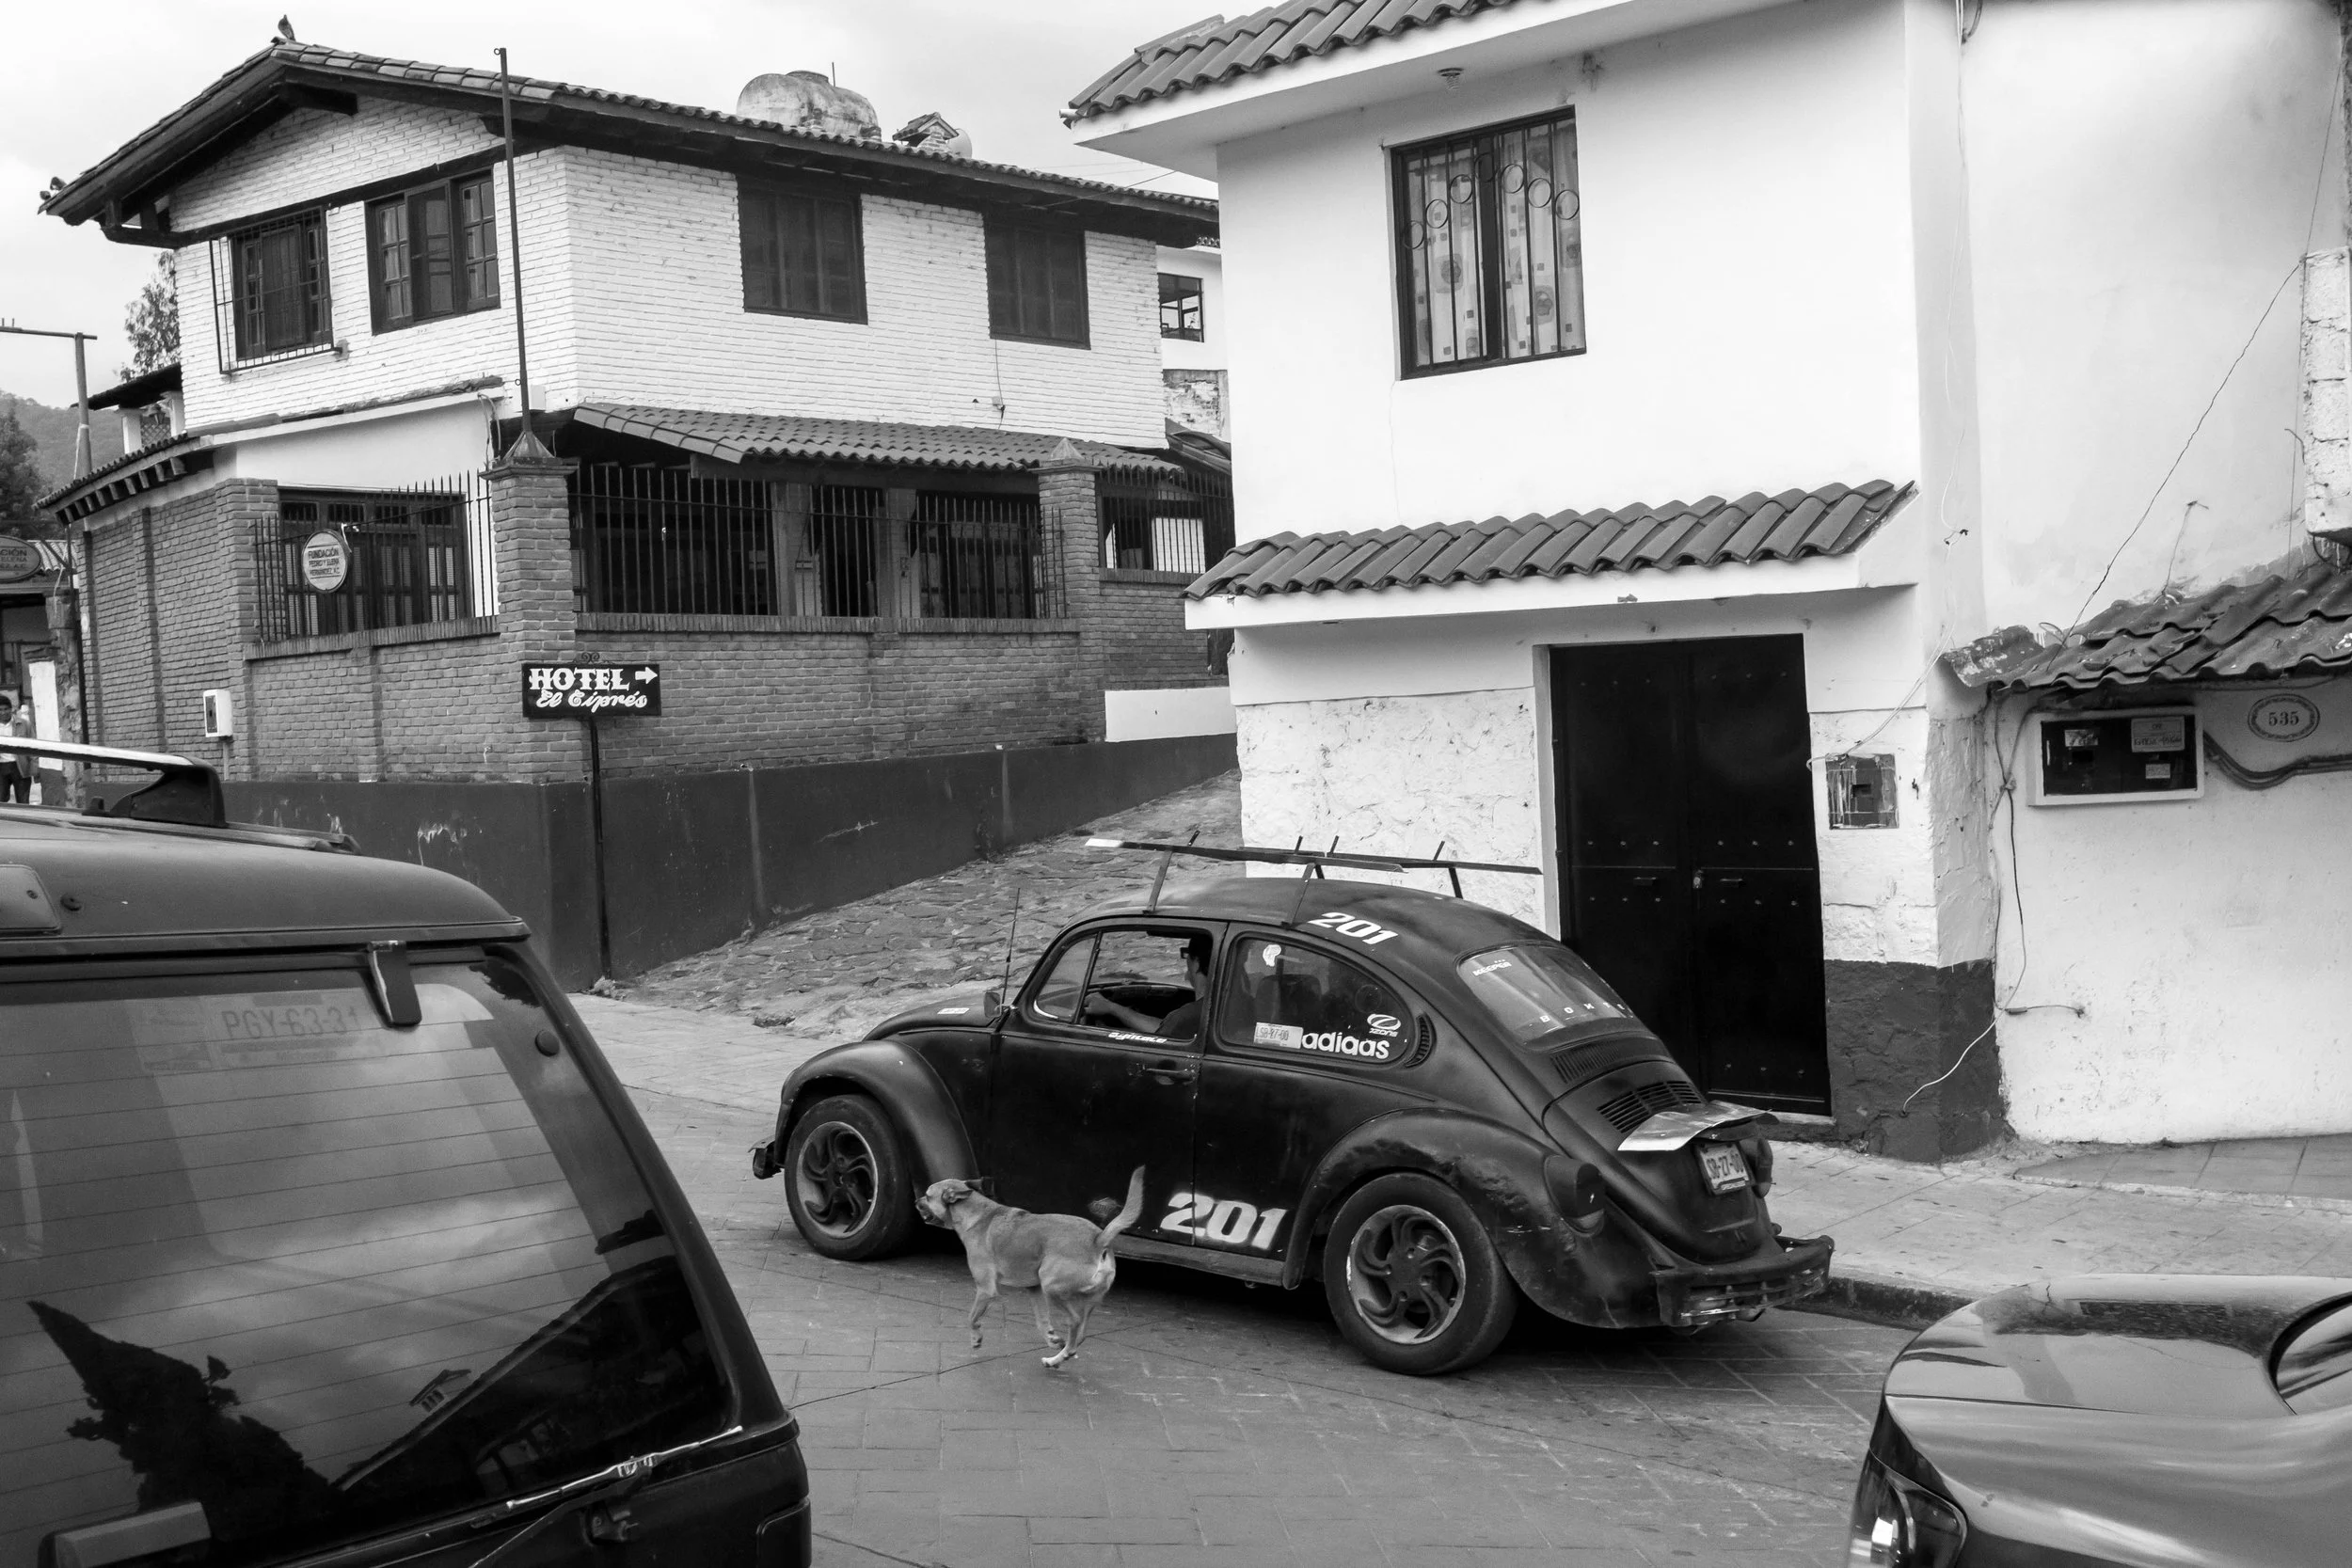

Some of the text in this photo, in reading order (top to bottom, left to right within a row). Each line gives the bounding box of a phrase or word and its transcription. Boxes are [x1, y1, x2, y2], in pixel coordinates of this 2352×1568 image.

[0, 546, 27, 556] CIÓN
[309, 547, 339, 559] FUNDACIÓN
[326, 558, 339, 566] ELENA
[529, 667, 630, 691] HOTEL
[536, 689, 648, 713] El Ciprés
[2268, 711, 2299, 726] 535
[1307, 911, 1399, 945] 201
[1471, 961, 1513, 976] KEEPER
[1159, 1192, 1289, 1250] 201
